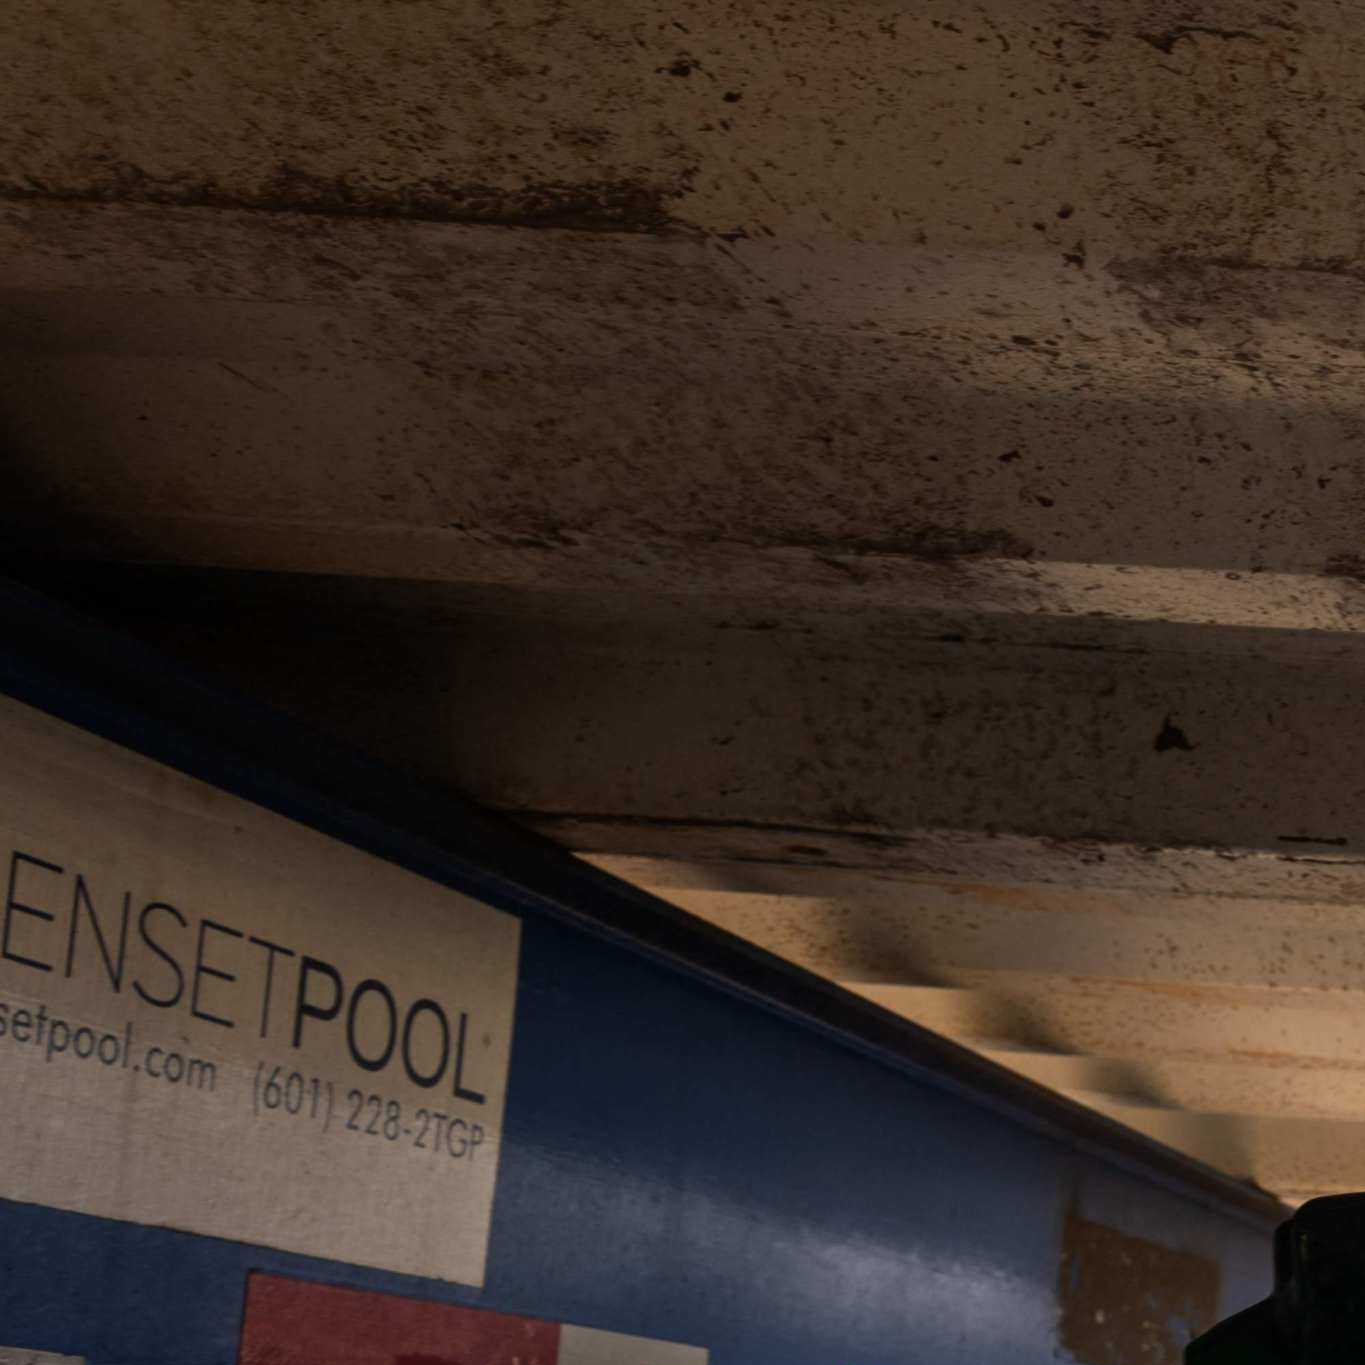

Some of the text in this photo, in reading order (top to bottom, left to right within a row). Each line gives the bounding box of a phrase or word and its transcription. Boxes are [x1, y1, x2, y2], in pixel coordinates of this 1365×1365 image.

[1, 850, 486, 1104] ENSETPOOL
[253, 1060, 336, 1133] (601)
[346, 1088, 486, 1164] 228-2TGP
